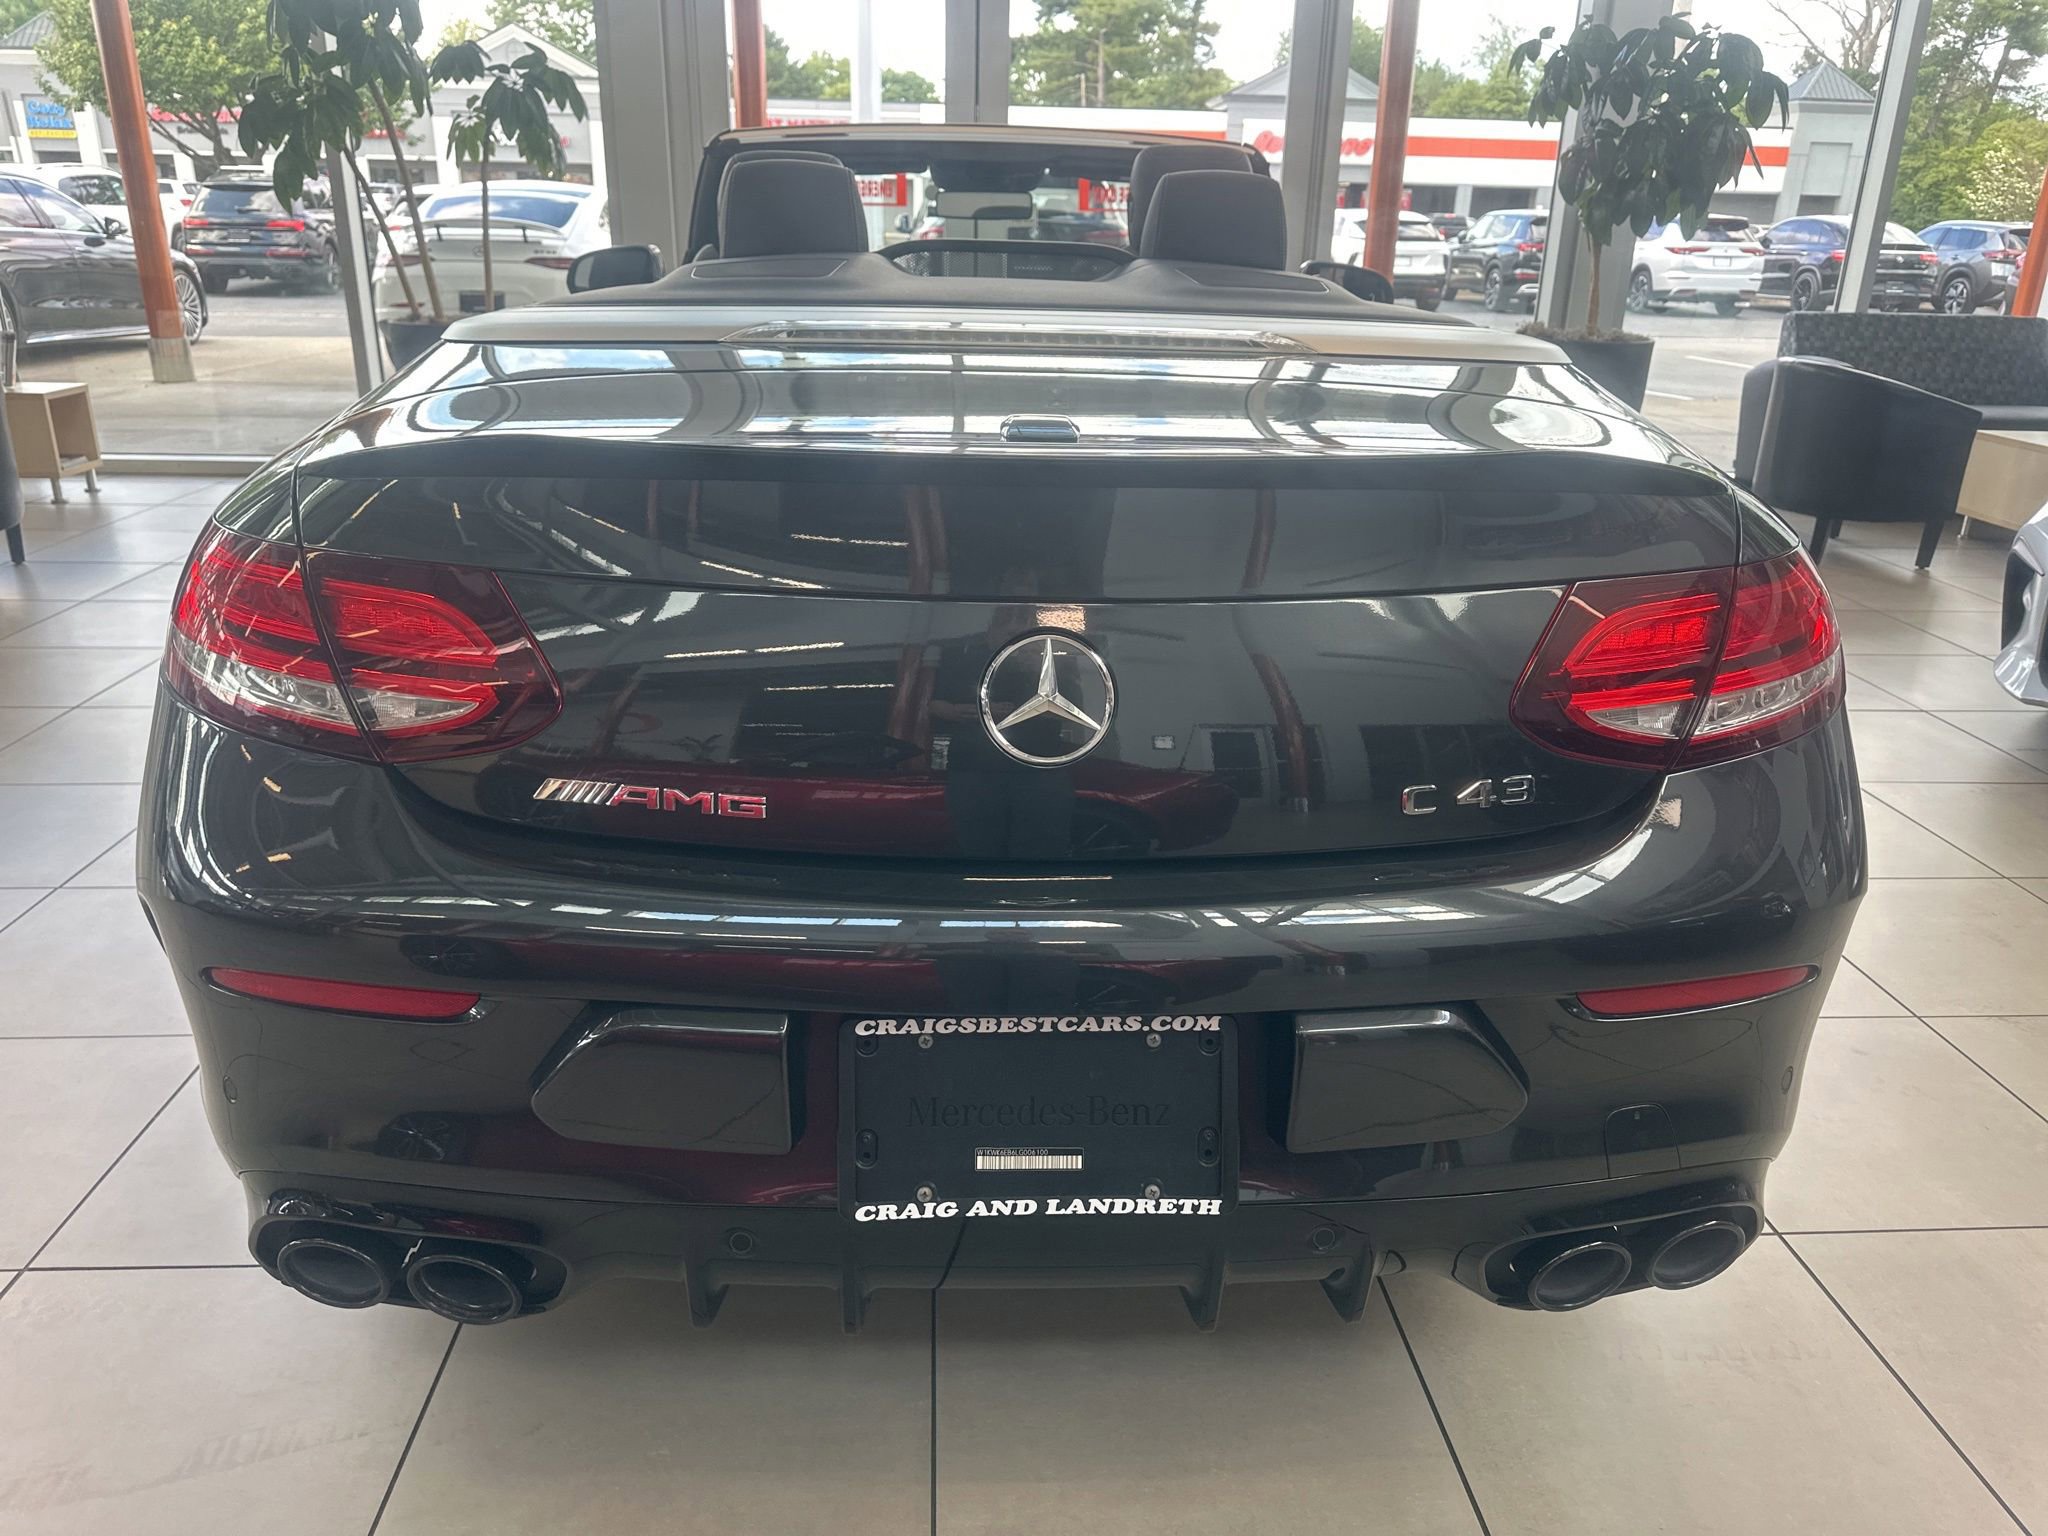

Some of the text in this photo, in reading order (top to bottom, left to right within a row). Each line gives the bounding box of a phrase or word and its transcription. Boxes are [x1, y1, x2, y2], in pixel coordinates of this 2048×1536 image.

[607, 783, 767, 819] AMG
[1402, 774, 1536, 815] C 43
[854, 1015, 1222, 1036] CRAIGSBESTCARS.COM
[905, 1095, 1170, 1128] Mercedes-Benz
[854, 1198, 1222, 1222] CRAIG AND LANDRETH
